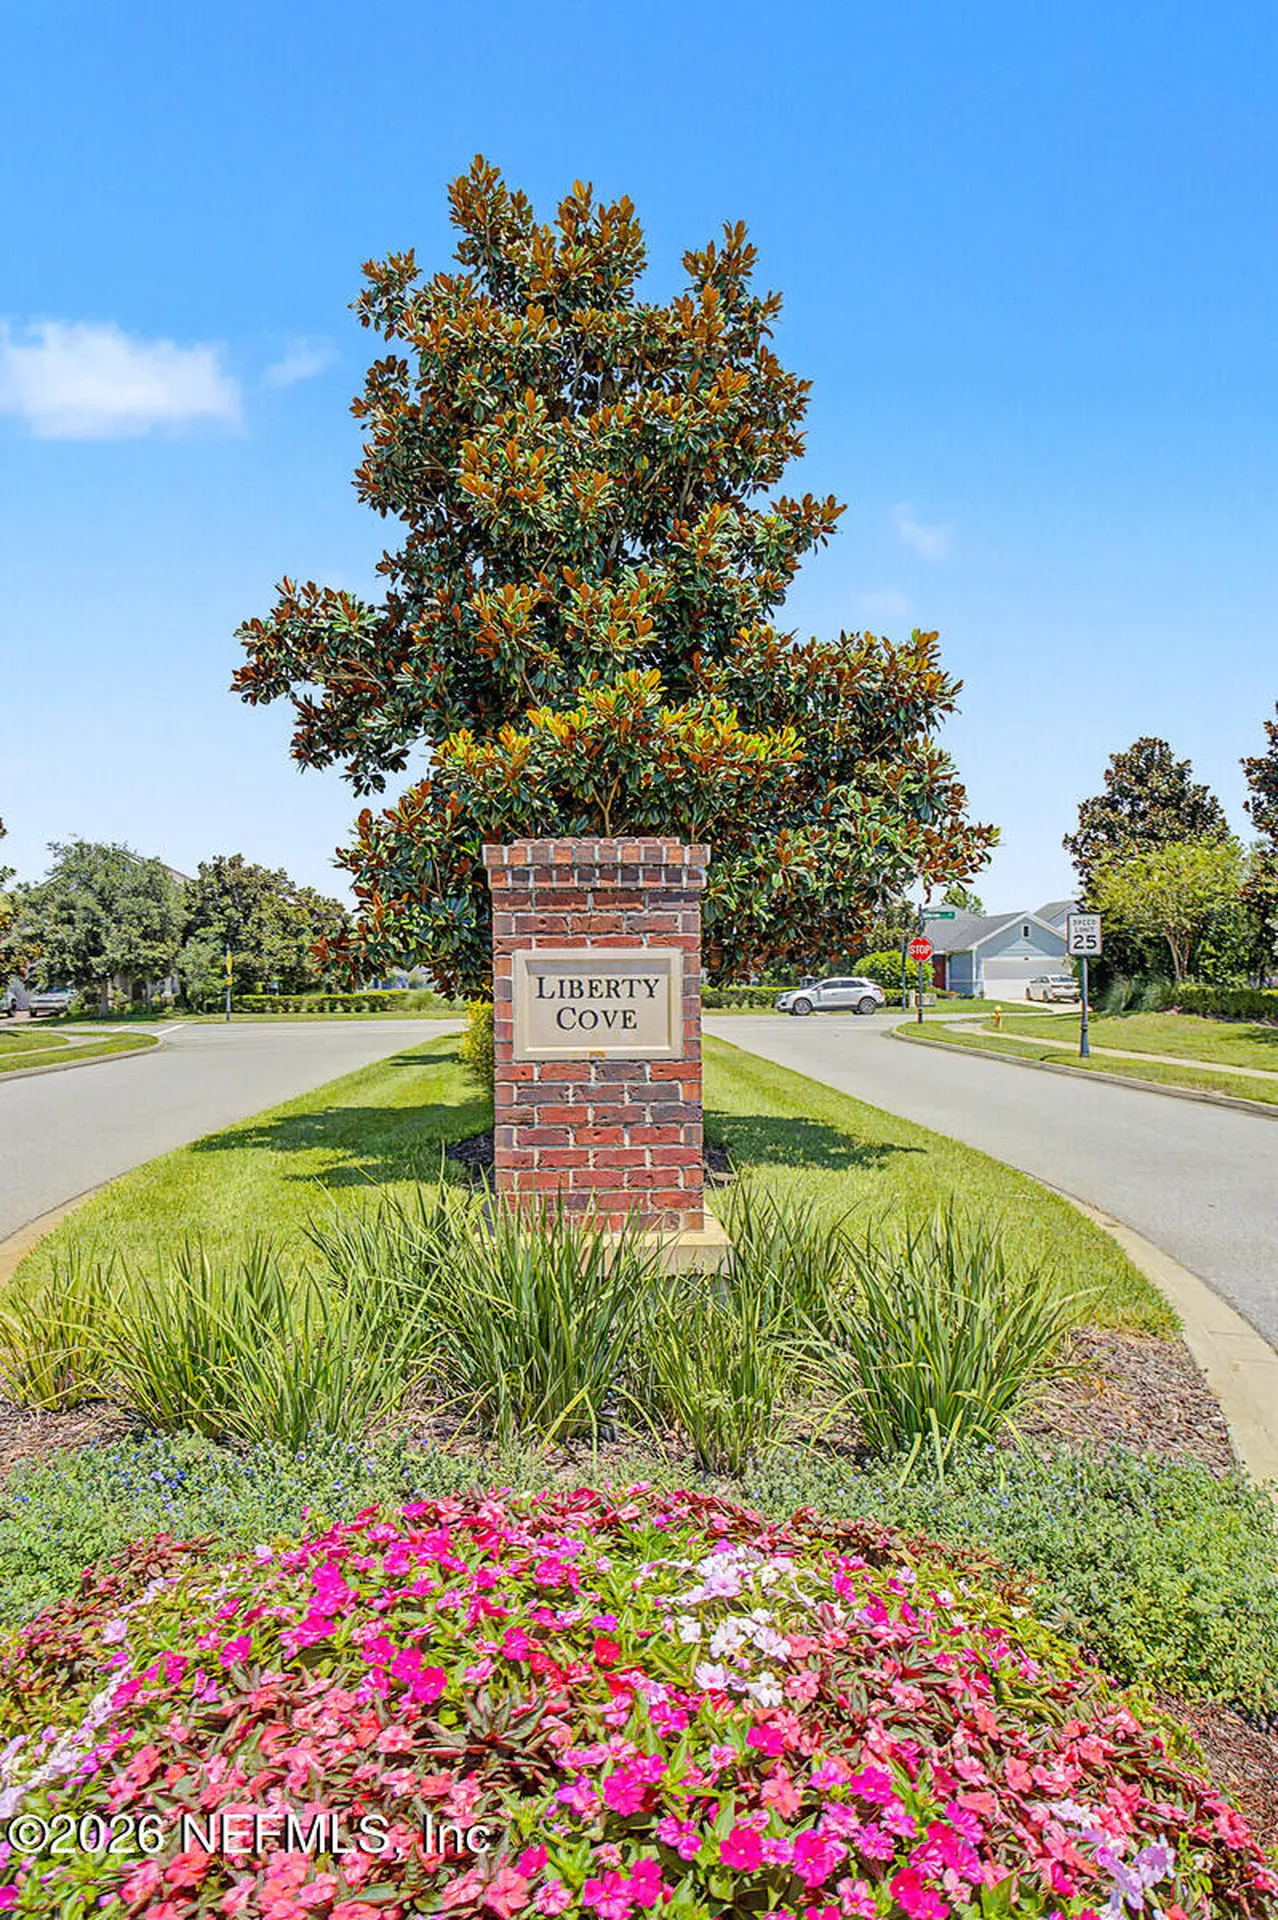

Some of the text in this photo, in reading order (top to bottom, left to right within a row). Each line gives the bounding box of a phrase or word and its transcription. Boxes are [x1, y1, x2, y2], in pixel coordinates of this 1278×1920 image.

[909, 945, 932, 955] STOP
[1073, 934, 1097, 949] 25
[536, 977, 660, 999] LIBERTY
[556, 1006, 638, 1030] COVE
